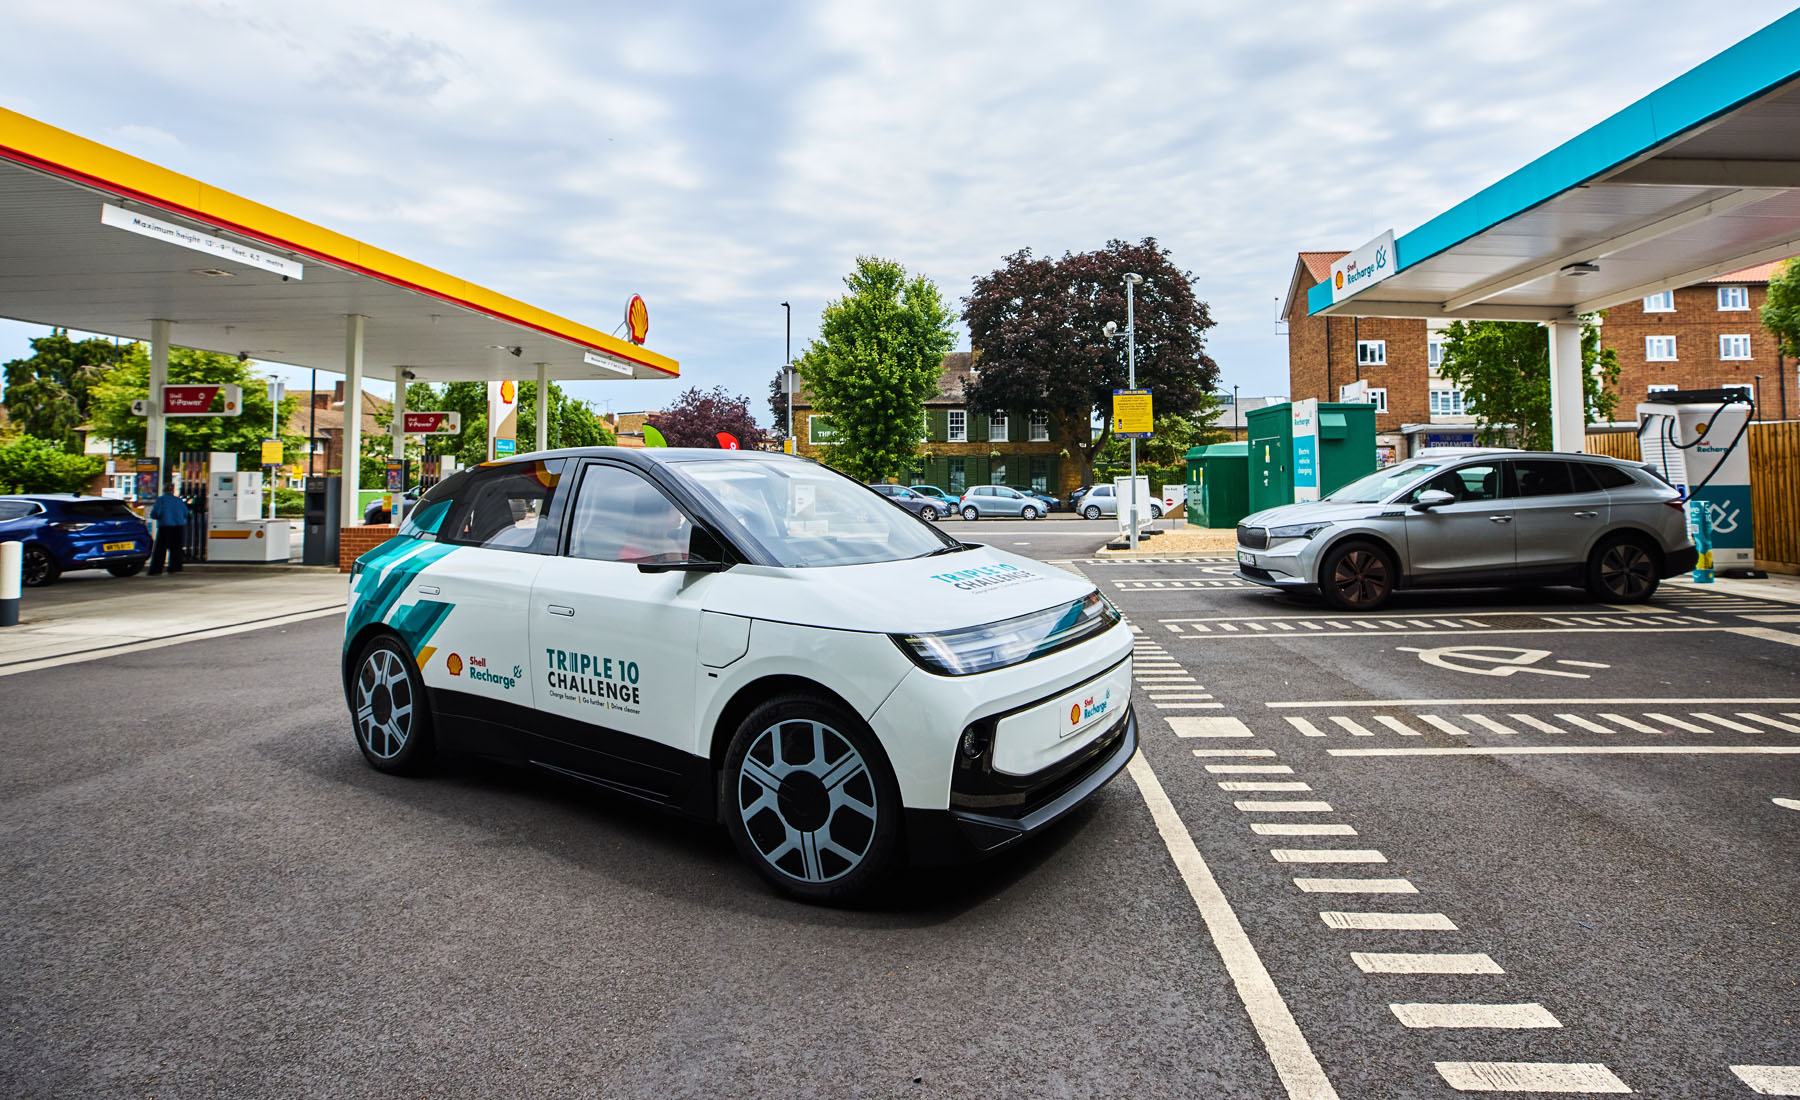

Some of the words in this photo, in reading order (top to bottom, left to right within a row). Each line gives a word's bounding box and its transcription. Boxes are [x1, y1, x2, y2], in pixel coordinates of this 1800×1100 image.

[133, 217, 174, 236] Maximum
[175, 229, 201, 243] height
[1347, 260, 1356, 273] Shell
[1347, 264, 1375, 285] Recharge
[134, 402, 142, 412] 4
[930, 566, 1001, 583] TRIPLE
[954, 570, 1036, 590] CHALLENGE
[469, 656, 486, 667] Shell
[546, 648, 613, 679] TRIPLE
[618, 660, 640, 685] 10
[469, 667, 515, 689] Recharge
[548, 671, 640, 705] CHALLENGE
[549, 690, 564, 700] Charge
[564, 693, 577, 701] faster
[590, 698, 605, 707] further
[611, 702, 623, 712] Drive
[623, 705, 641, 715] cleaner
[1084, 696, 1093, 708] Shell
[1084, 701, 1107, 719] Recharge
